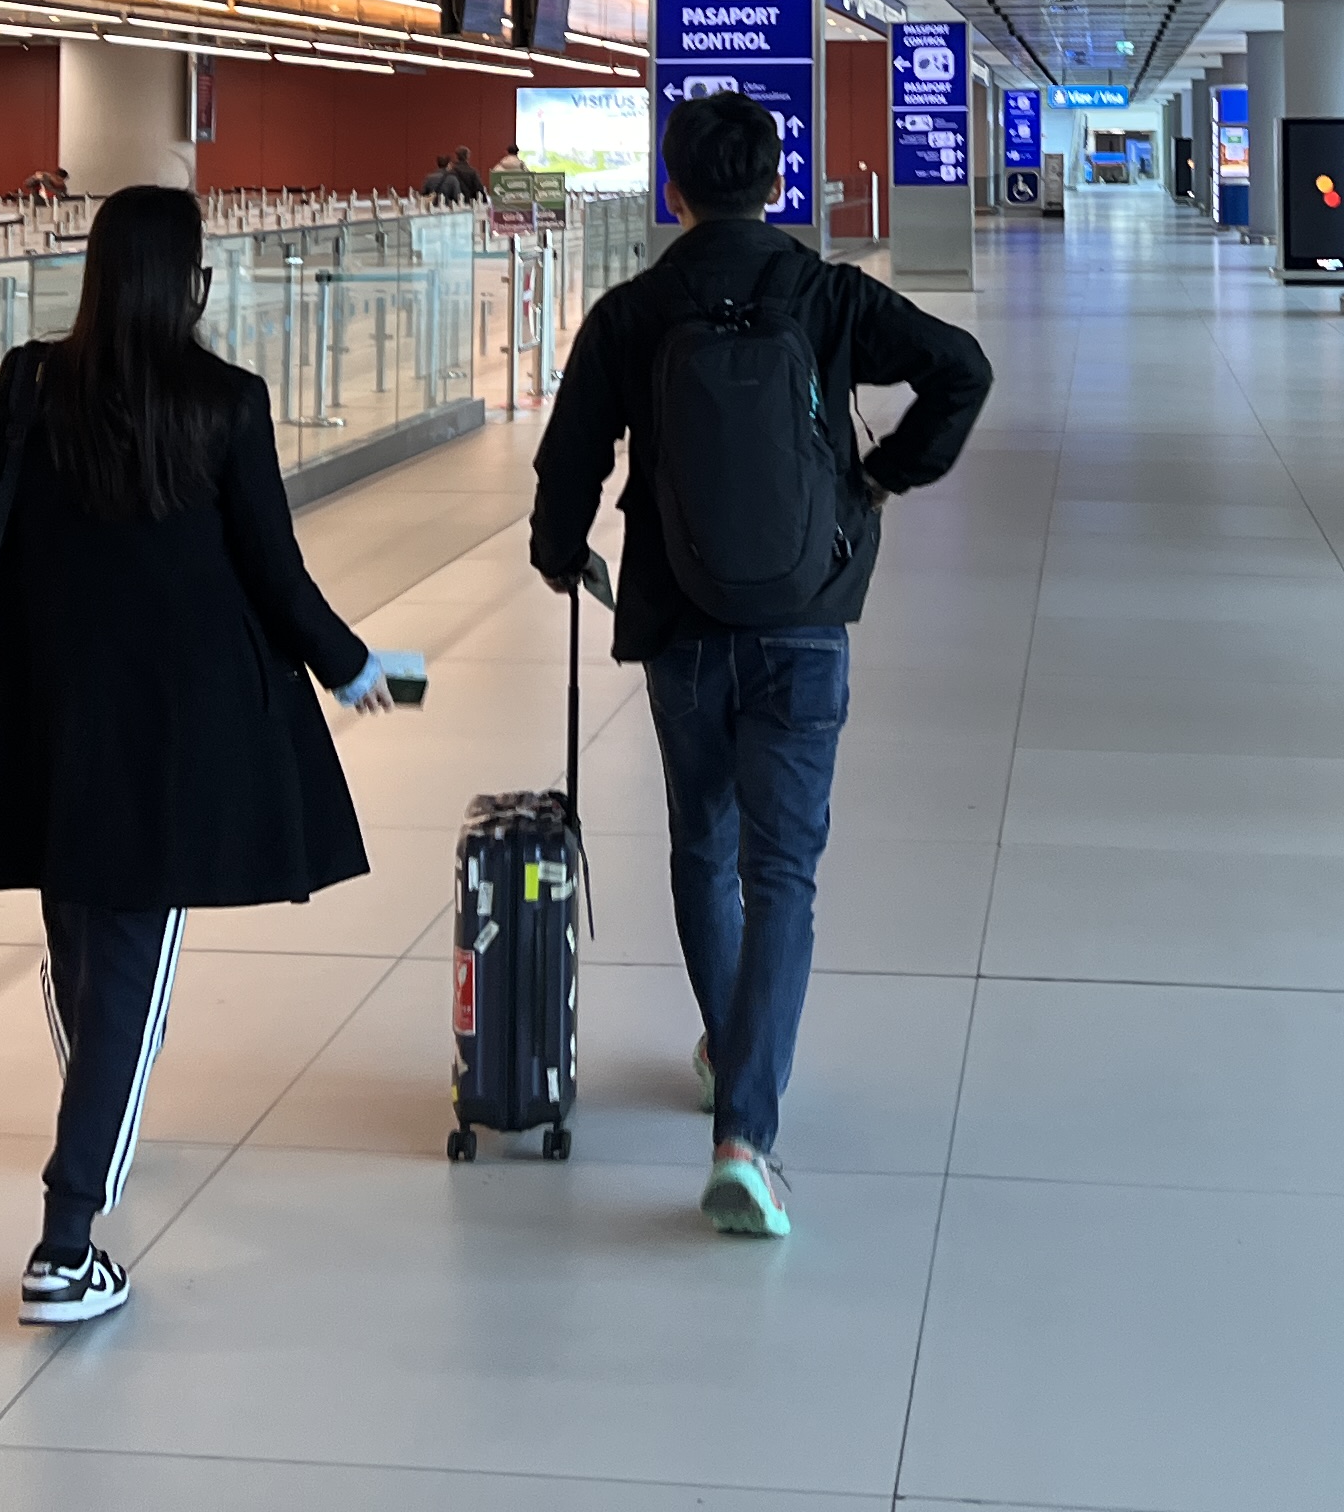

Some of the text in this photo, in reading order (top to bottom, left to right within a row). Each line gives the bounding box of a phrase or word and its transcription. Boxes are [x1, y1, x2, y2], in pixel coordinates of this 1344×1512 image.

[682, 7, 780, 27] PASAPORT
[903, 24, 950, 36] PASSPORT
[682, 31, 771, 50] KONTROL
[903, 36, 947, 47] CONTROL
[903, 82, 952, 93] PASAPORT
[903, 94, 949, 105] KONTROL
